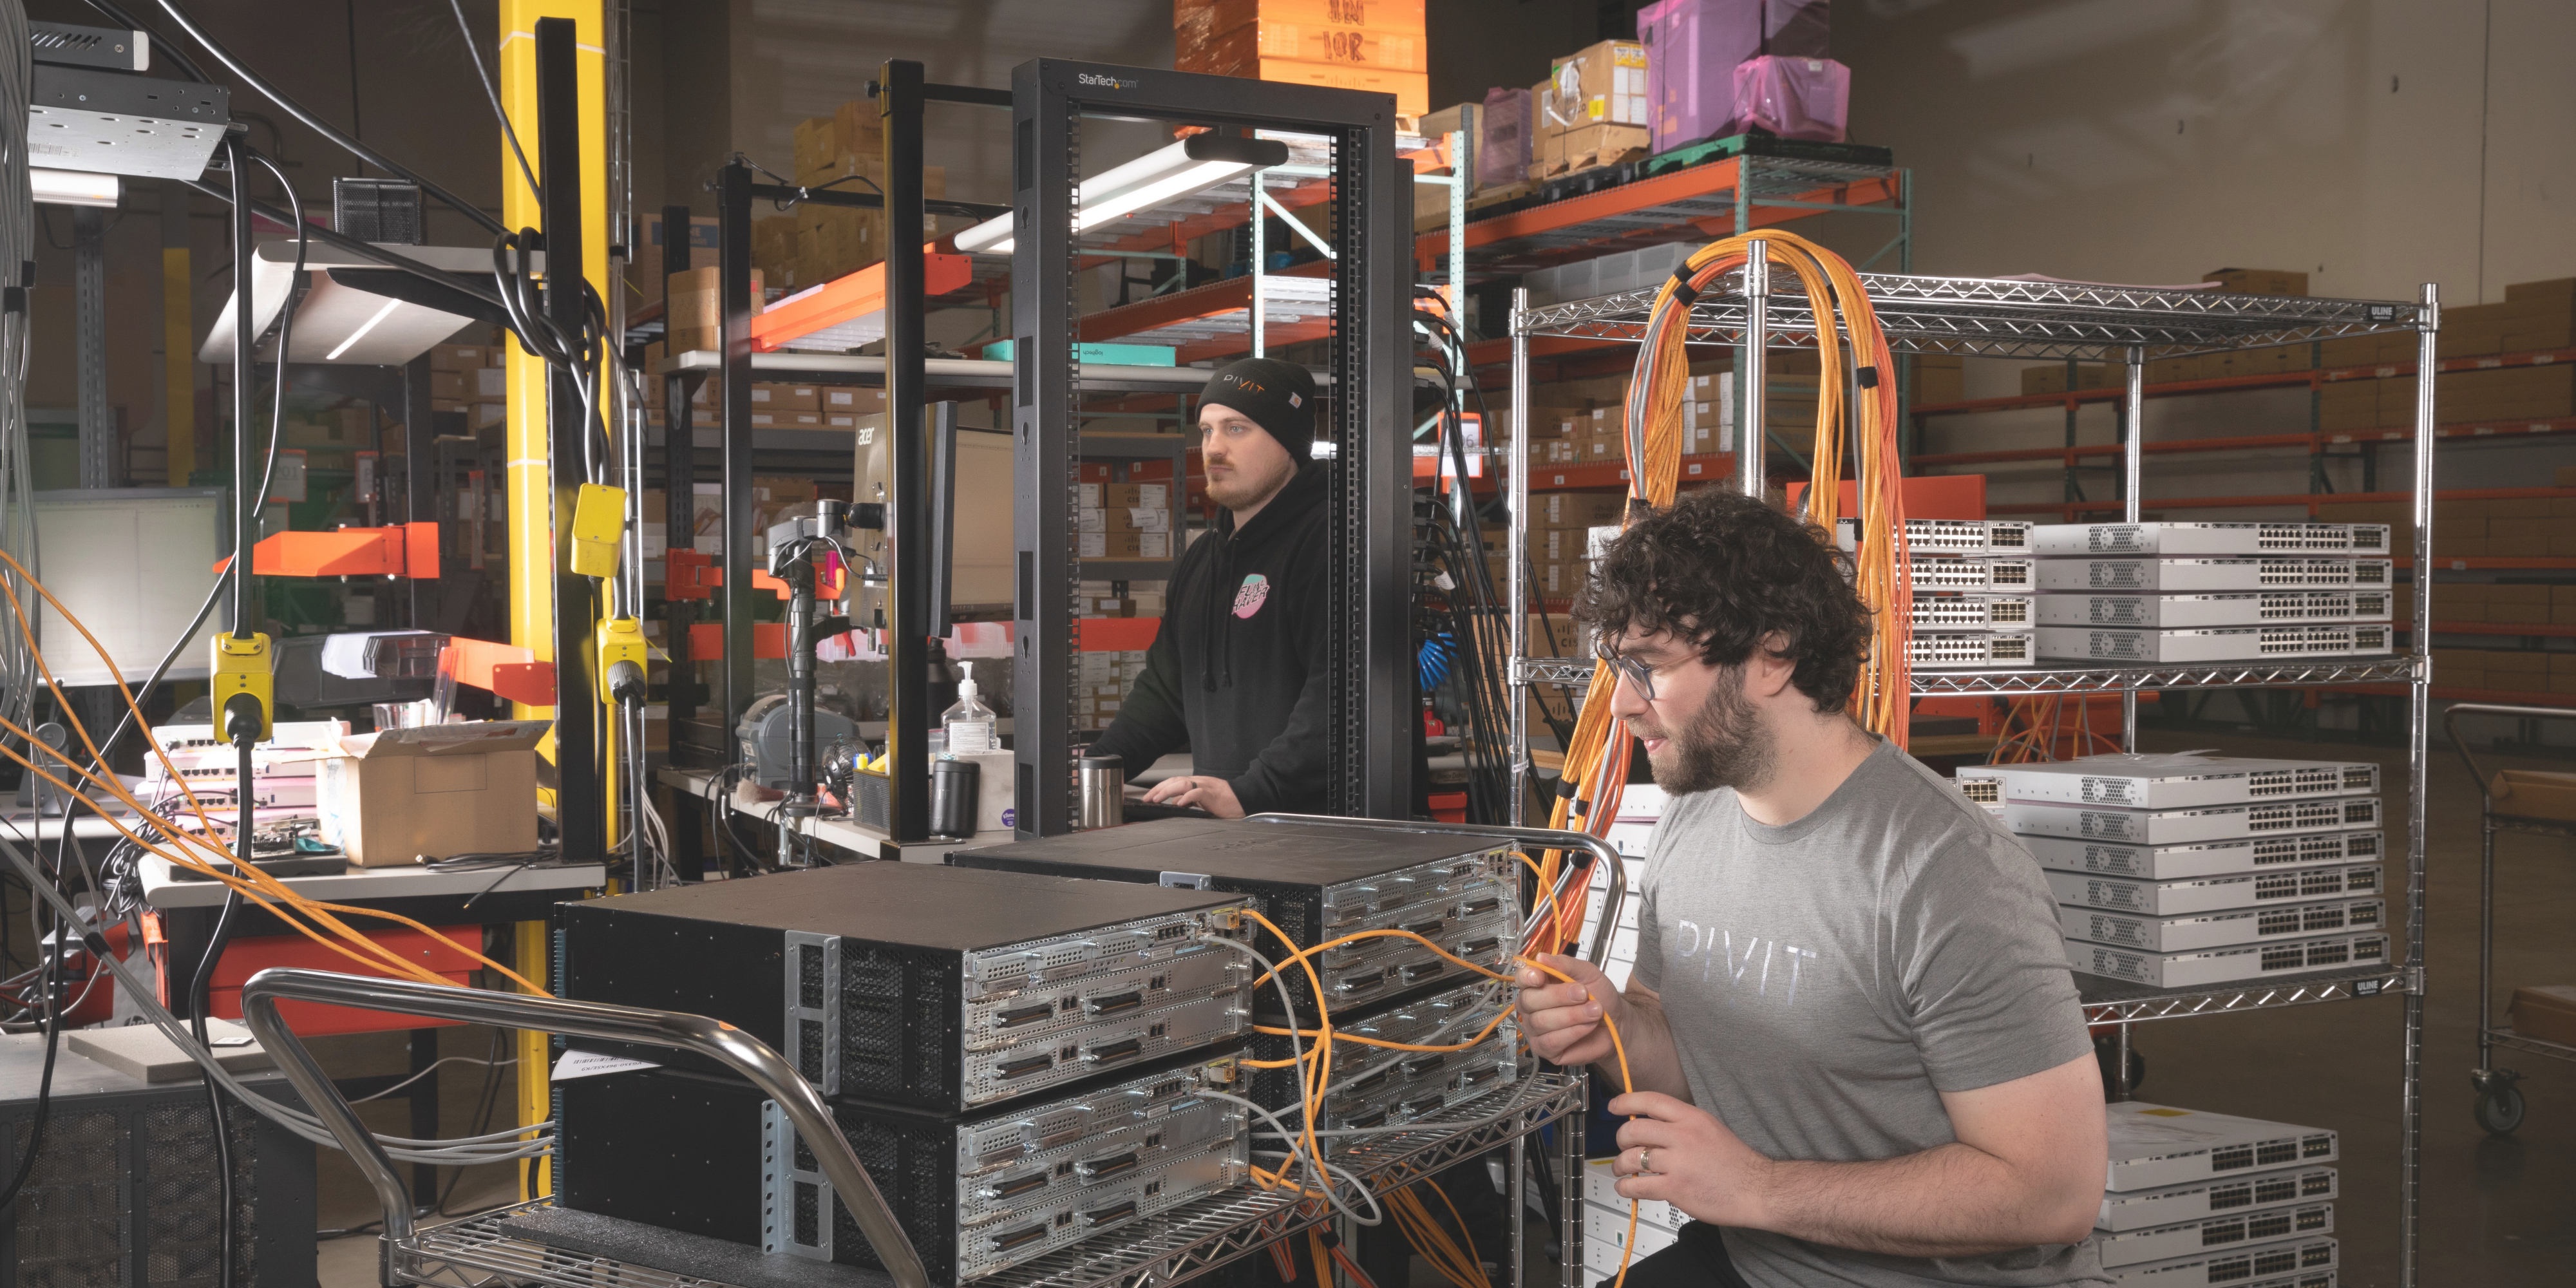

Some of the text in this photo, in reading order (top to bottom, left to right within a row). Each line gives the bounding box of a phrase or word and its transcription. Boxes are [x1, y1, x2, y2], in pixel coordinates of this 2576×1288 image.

[1079, 73, 1137, 89] StarTech.com
[2372, 306, 2392, 315] ULINE
[1224, 374, 1265, 393] PIVIT
[858, 427, 875, 446] acer
[1086, 785, 1119, 798] PIVIT
[1674, 919, 1817, 1007] PIVIT
[2358, 980, 2378, 991] ULINE
[974, 1003, 999, 1012] SM-D-48FXS-E
[973, 1054, 998, 1065] SM-D-48FXS-E
[968, 1175, 994, 1186] SM-D-48FXS-E
[968, 1227, 994, 1239] SM-D-48FXS-E
